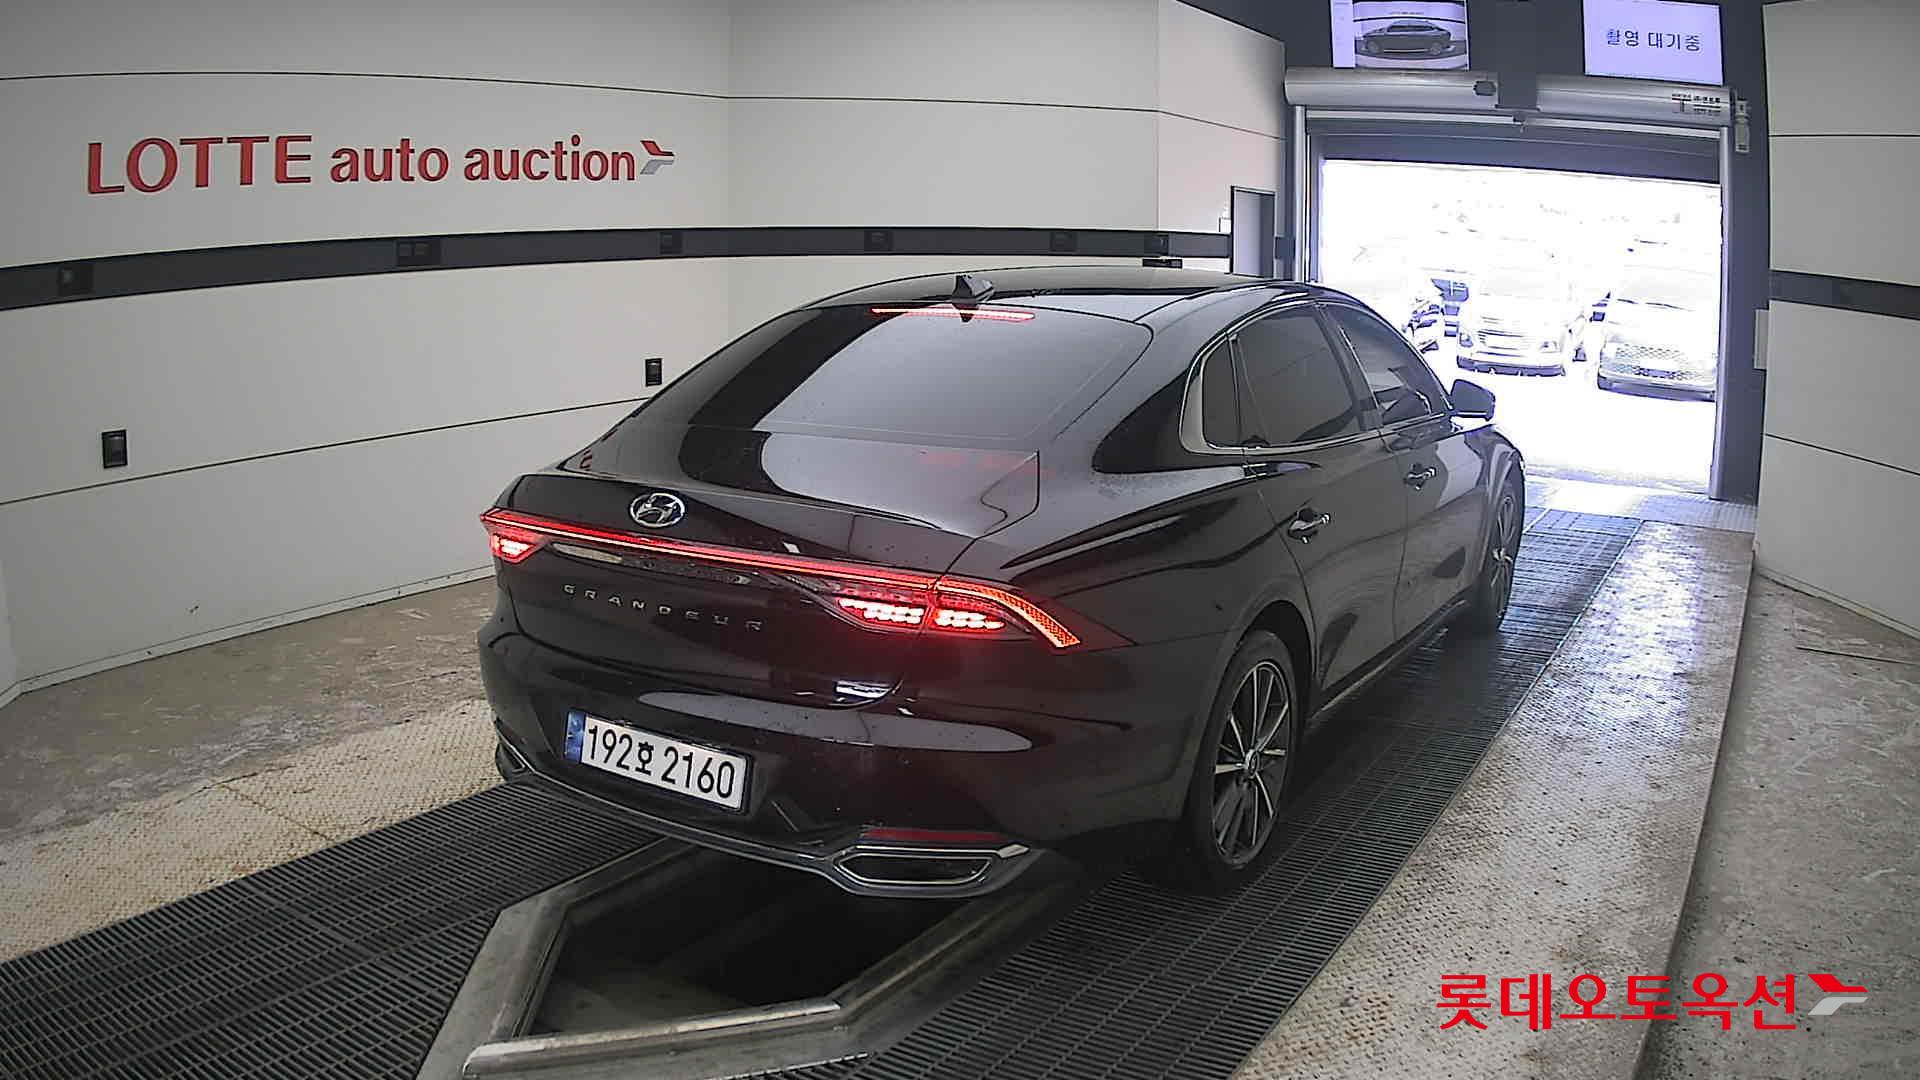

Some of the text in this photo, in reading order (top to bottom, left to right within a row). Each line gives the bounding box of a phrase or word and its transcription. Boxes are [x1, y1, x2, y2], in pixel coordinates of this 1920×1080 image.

[1647, 31, 1701, 51] 대기중
[86, 134, 637, 194] LOTTE auto auction
[562, 583, 764, 632] GRANDEUR
[660, 745, 736, 799] 2160
